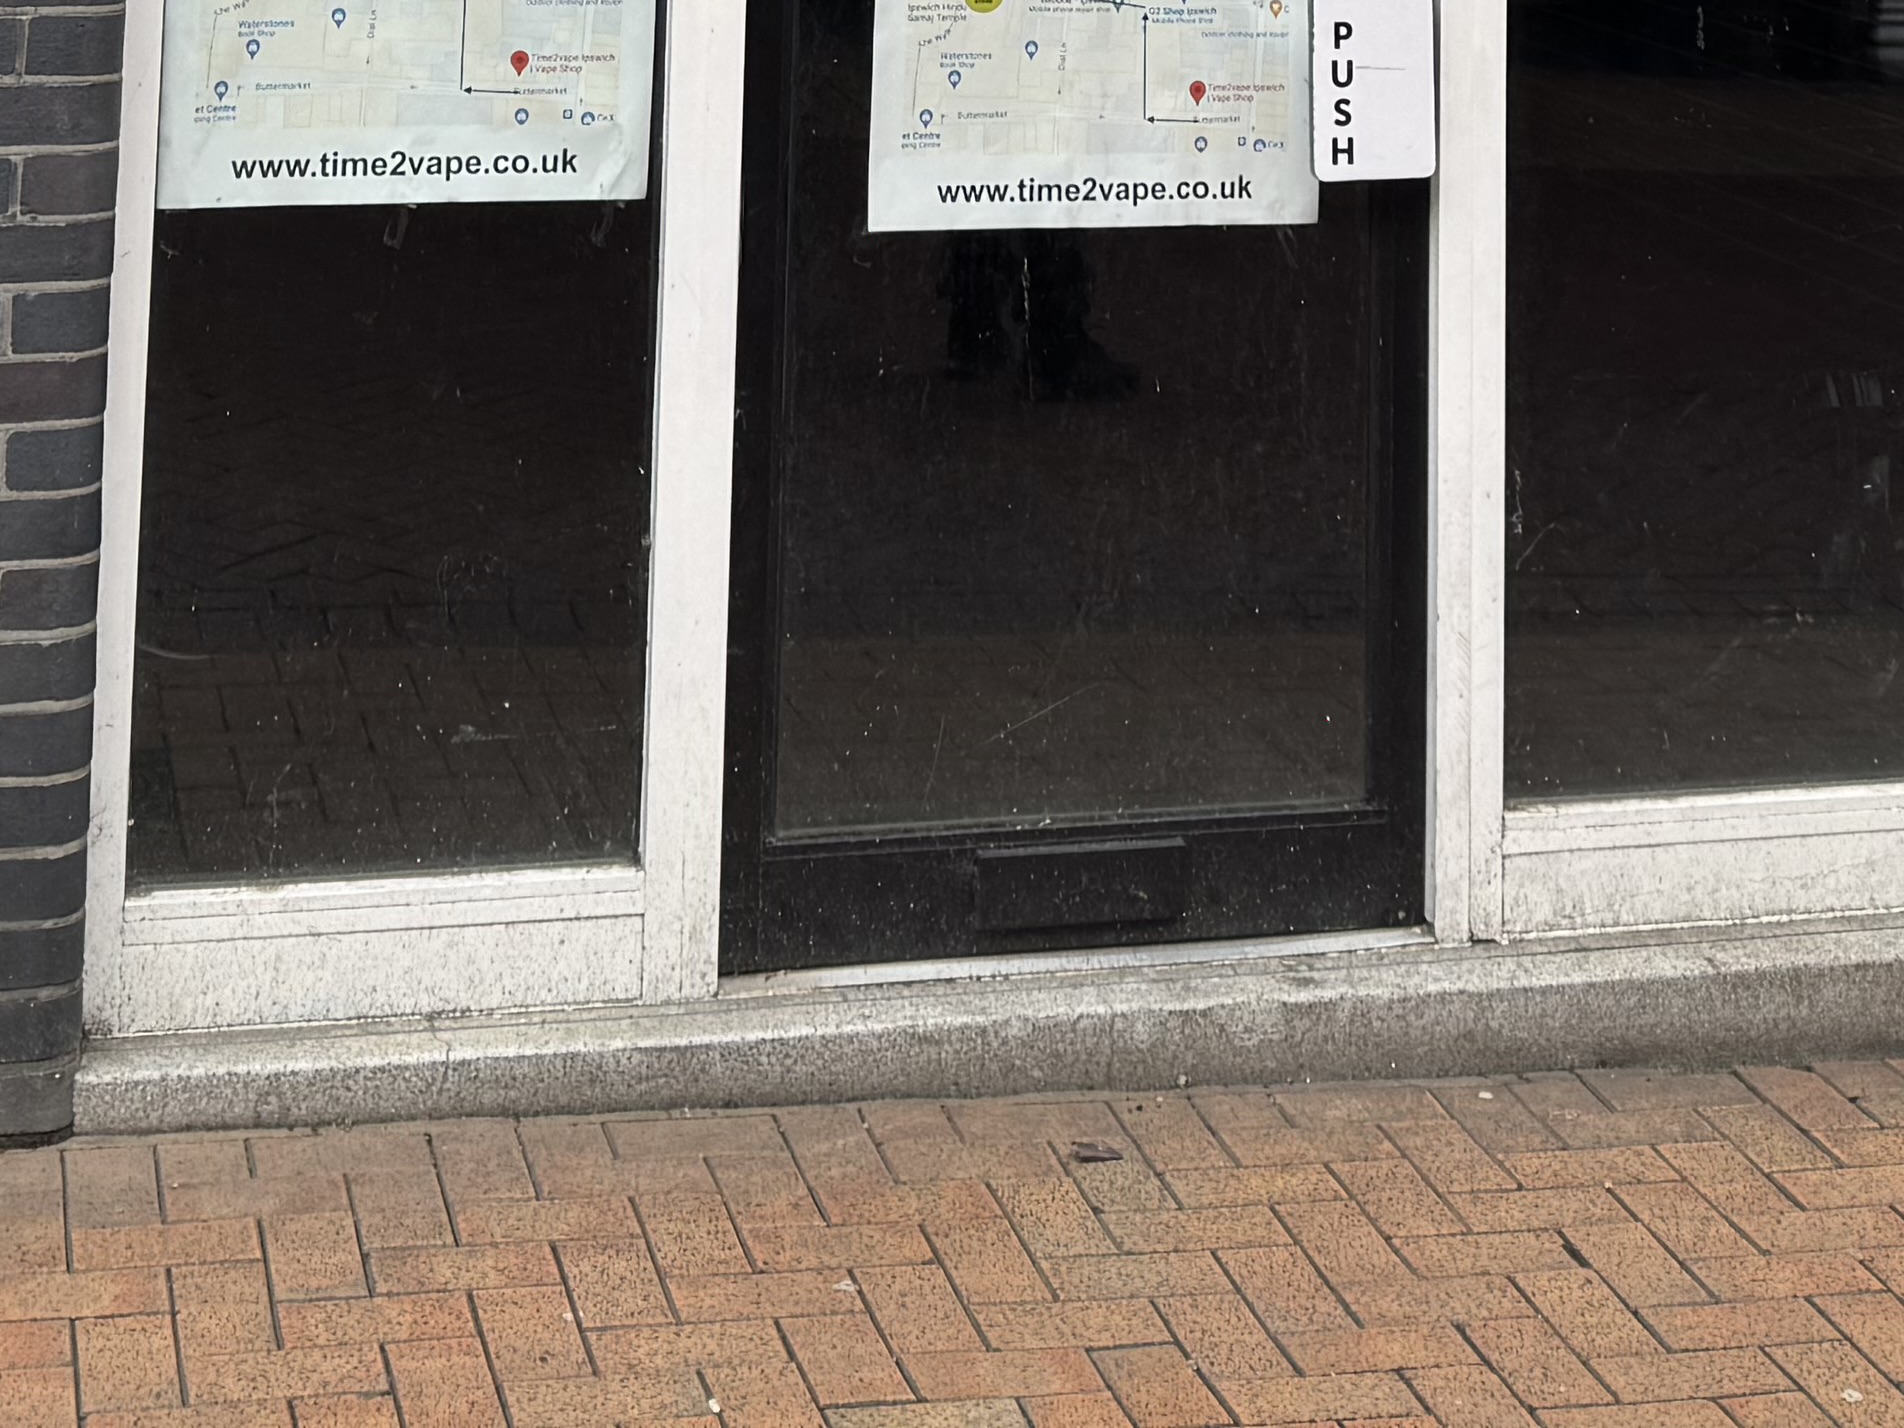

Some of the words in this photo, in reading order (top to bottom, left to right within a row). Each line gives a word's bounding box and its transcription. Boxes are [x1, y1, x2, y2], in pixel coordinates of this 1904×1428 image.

[1330, 22, 1355, 166] PUSH
[232, 148, 577, 181] www.time2vape.co.uk
[937, 174, 1252, 207] www.time2vape.co.uk
